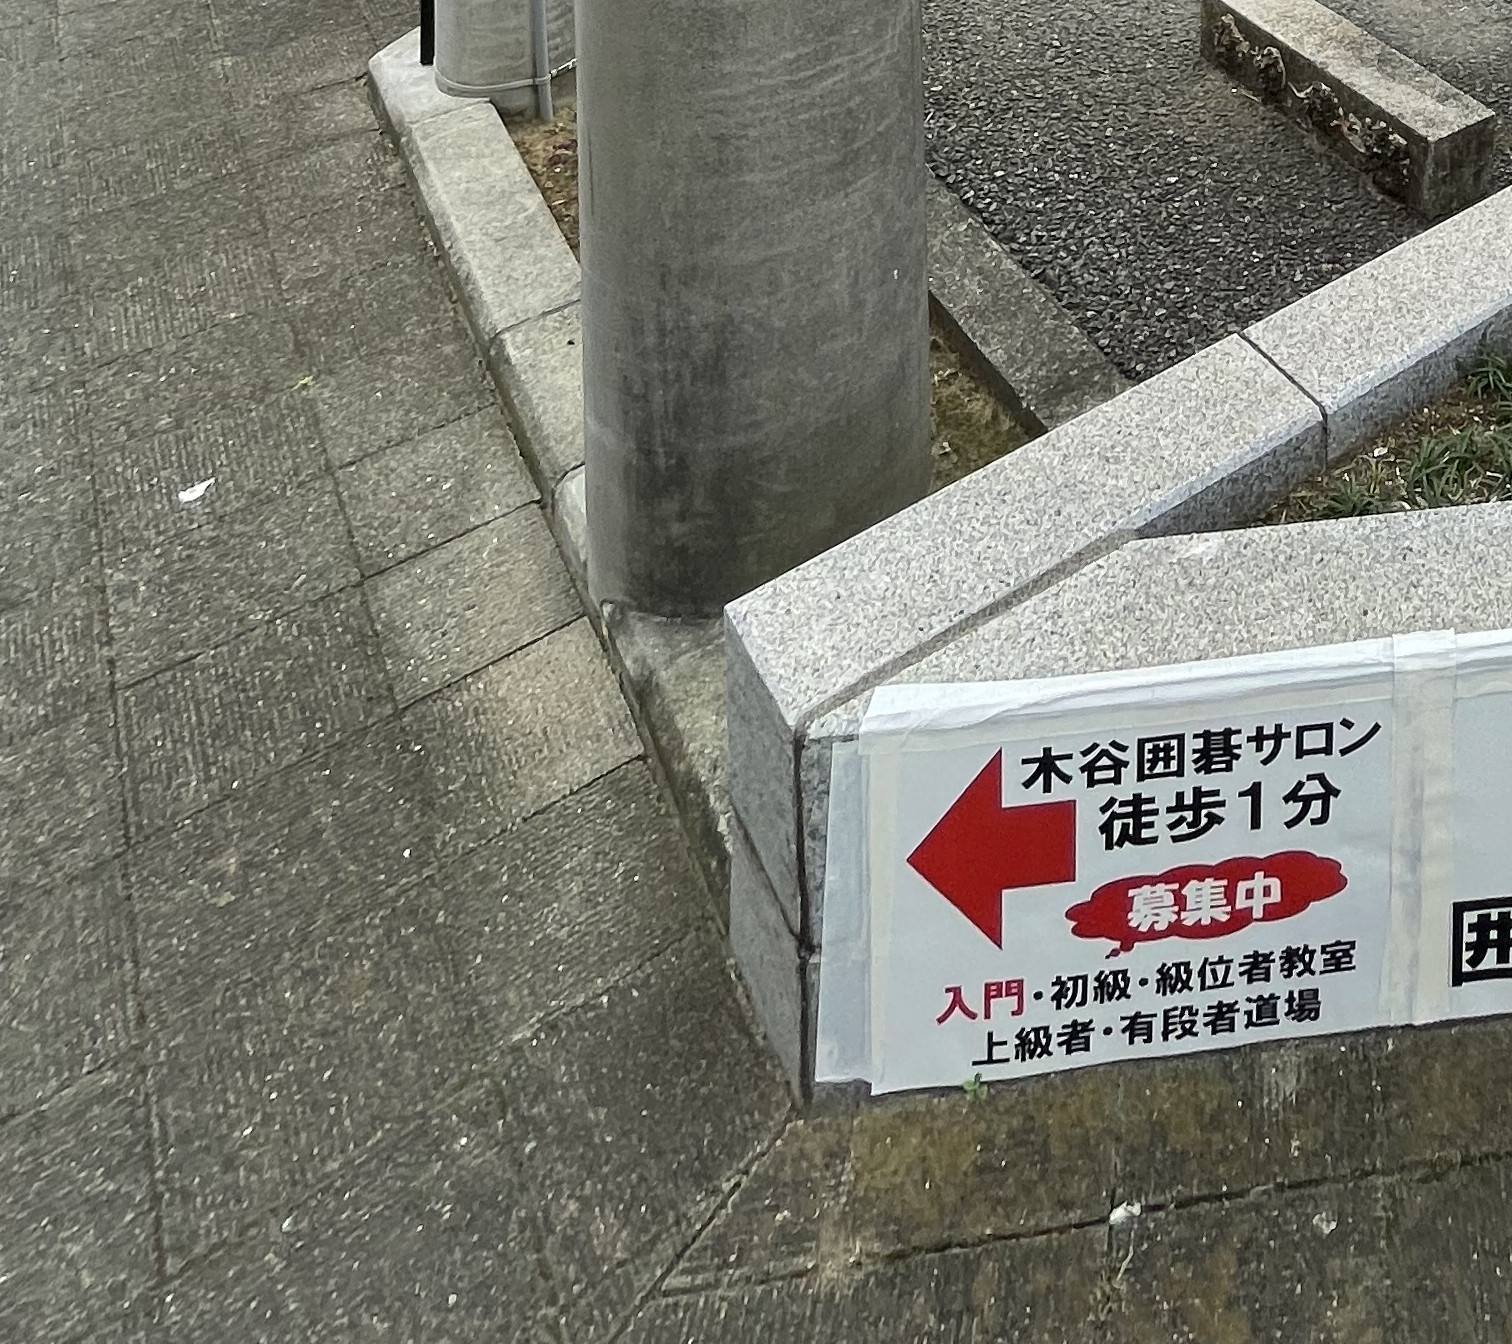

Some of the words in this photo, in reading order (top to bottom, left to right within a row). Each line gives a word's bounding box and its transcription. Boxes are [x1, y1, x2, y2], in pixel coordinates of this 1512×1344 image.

[1021, 717, 1382, 794] 木谷囲碁サロン
[1098, 772, 1342, 851] 徒歩1分
[1126, 870, 1283, 929] 募集中
[971, 987, 1322, 1067] 上級者・有段者道場
